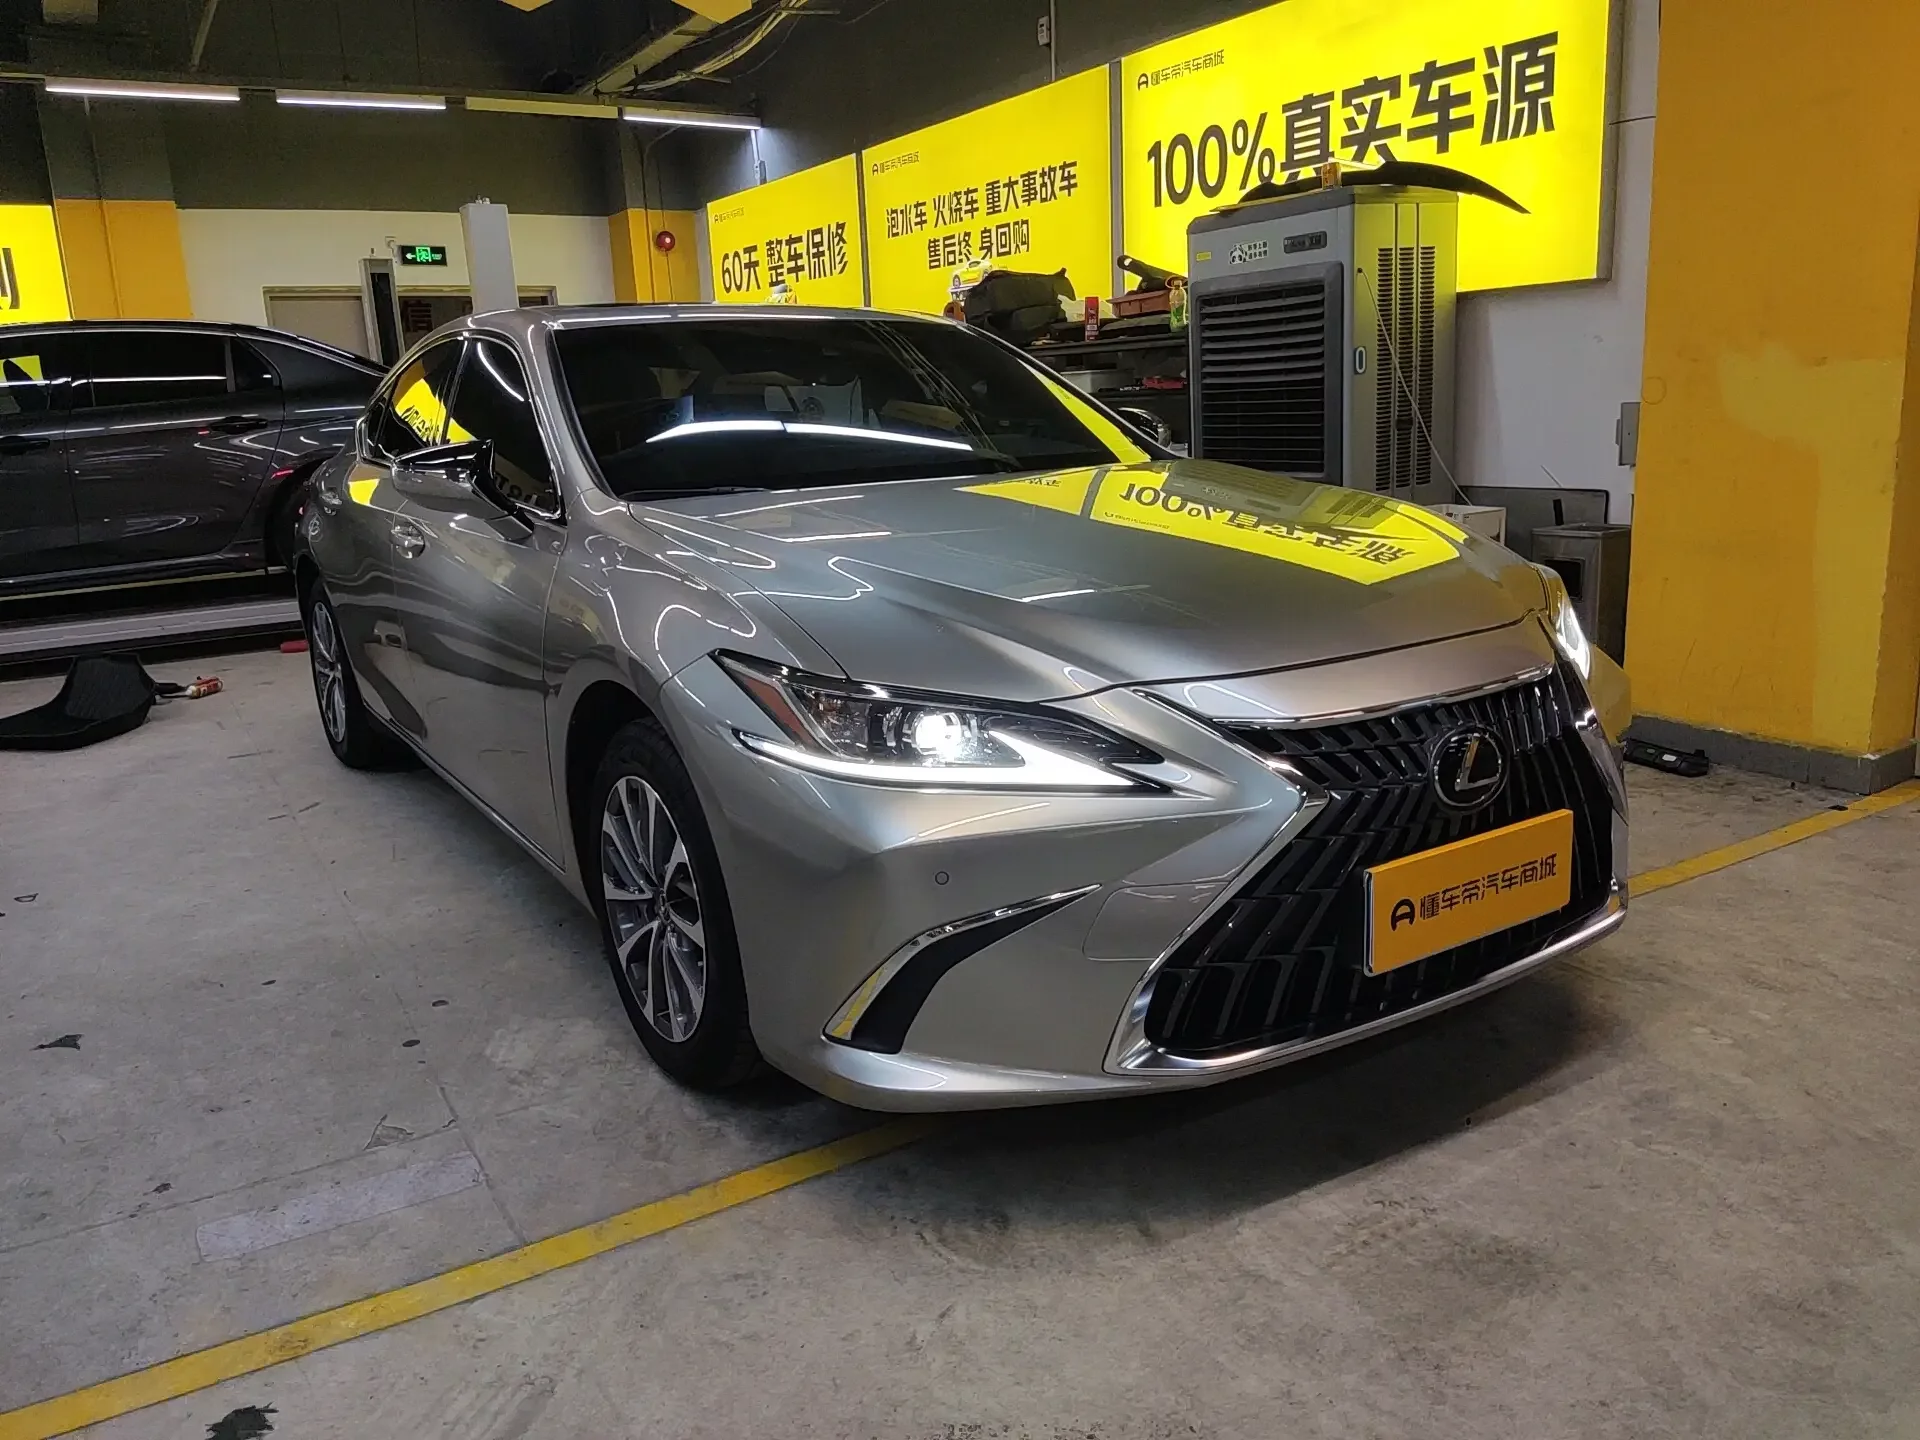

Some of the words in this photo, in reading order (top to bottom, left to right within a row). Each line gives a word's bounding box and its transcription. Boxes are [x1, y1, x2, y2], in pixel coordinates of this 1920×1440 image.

[1147, 31, 1559, 207] 100%真实车源
[886, 200, 928, 239] 泡水车
[932, 187, 980, 228] 火烧车
[985, 160, 1079, 217] 重大事故车
[721, 244, 762, 294] 60天
[765, 221, 849, 288] 整车保修
[1420, 853, 1558, 920] 懂车帝汽车商城
